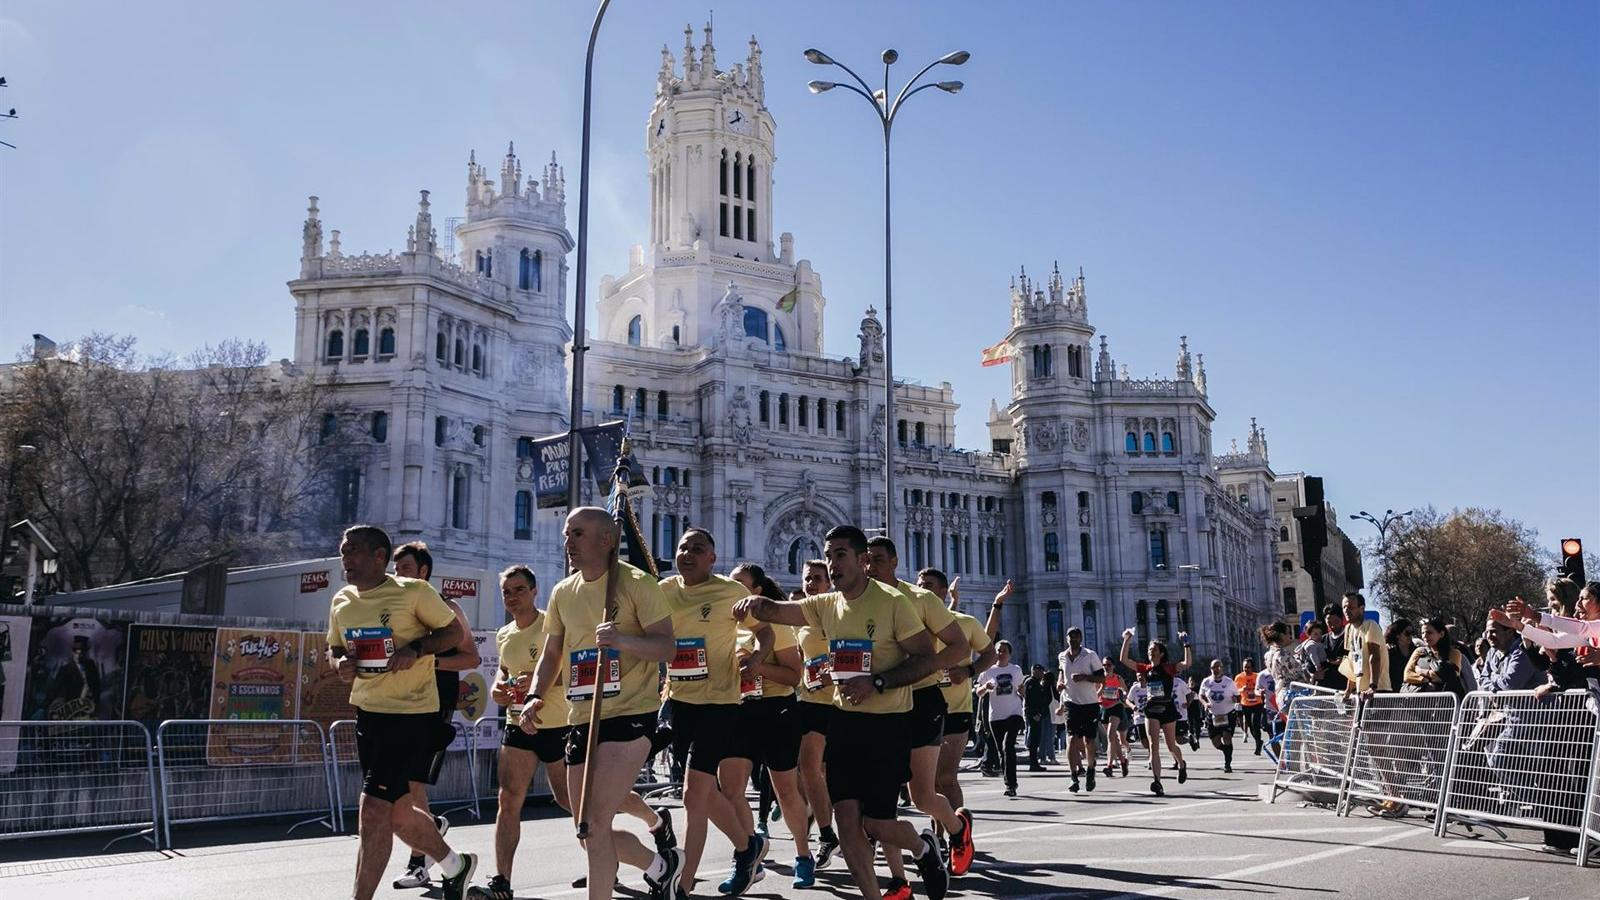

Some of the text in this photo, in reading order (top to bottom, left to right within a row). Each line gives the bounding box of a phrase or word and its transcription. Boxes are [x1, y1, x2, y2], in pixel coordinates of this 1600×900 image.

[302, 572, 329, 584] REMSA
[443, 580, 475, 591] REMSA
[140, 630, 169, 650] GUNS
[183, 631, 214, 652] ROSES
[231, 685, 280, 695] 3 ESCENARIOS
